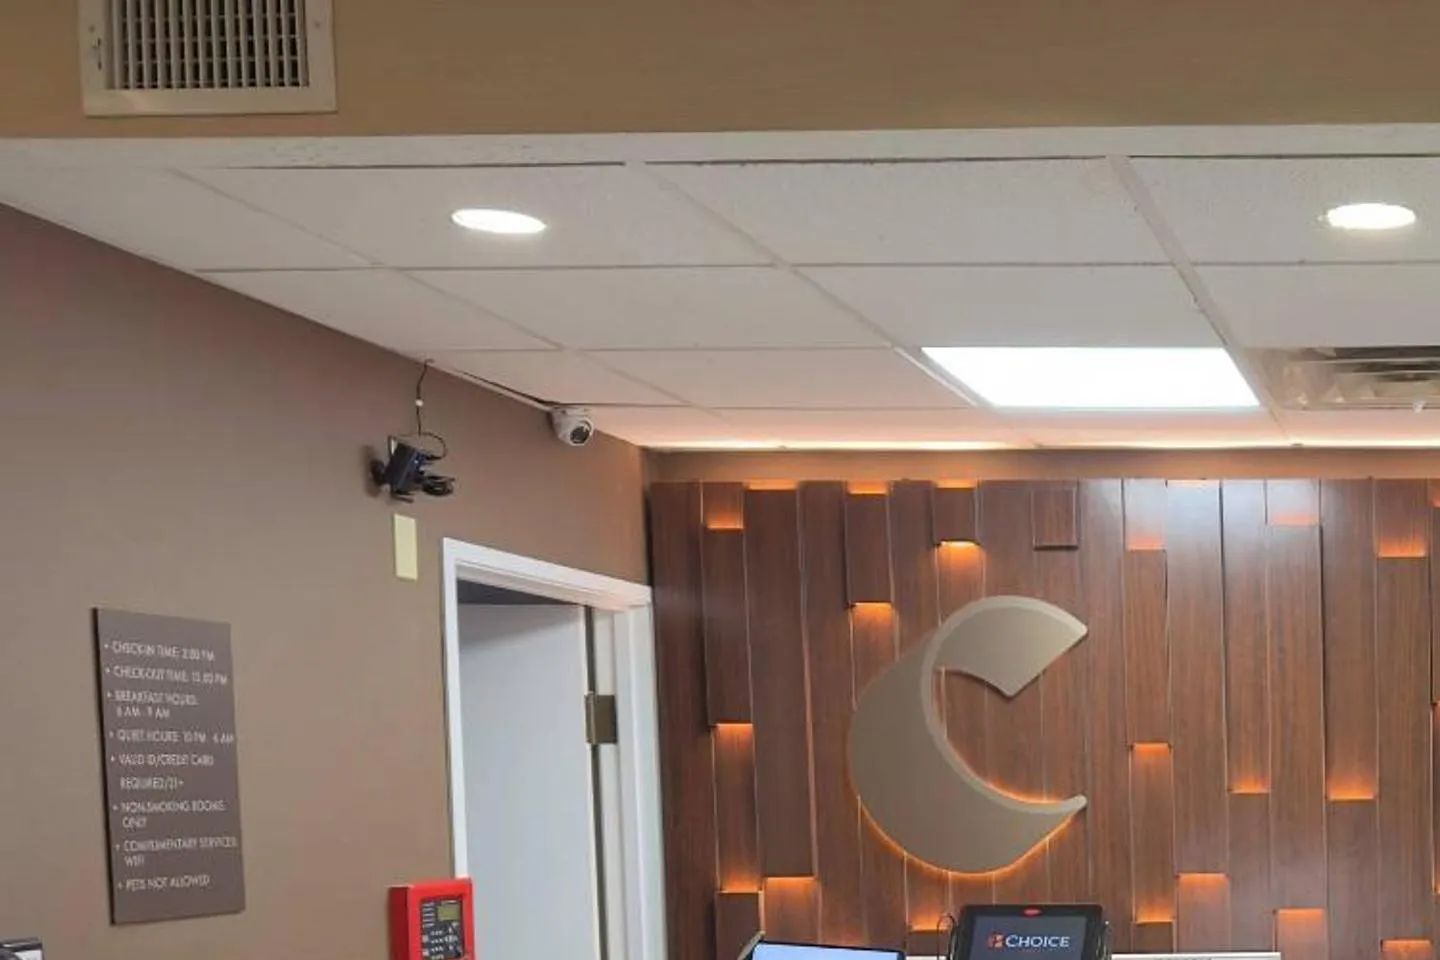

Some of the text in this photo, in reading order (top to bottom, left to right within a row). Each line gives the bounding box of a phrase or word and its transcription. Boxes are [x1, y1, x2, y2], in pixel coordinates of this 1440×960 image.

[126, 874, 210, 891] PETS NOT ALLOWED
[1005, 934, 1071, 948] CHOICE
